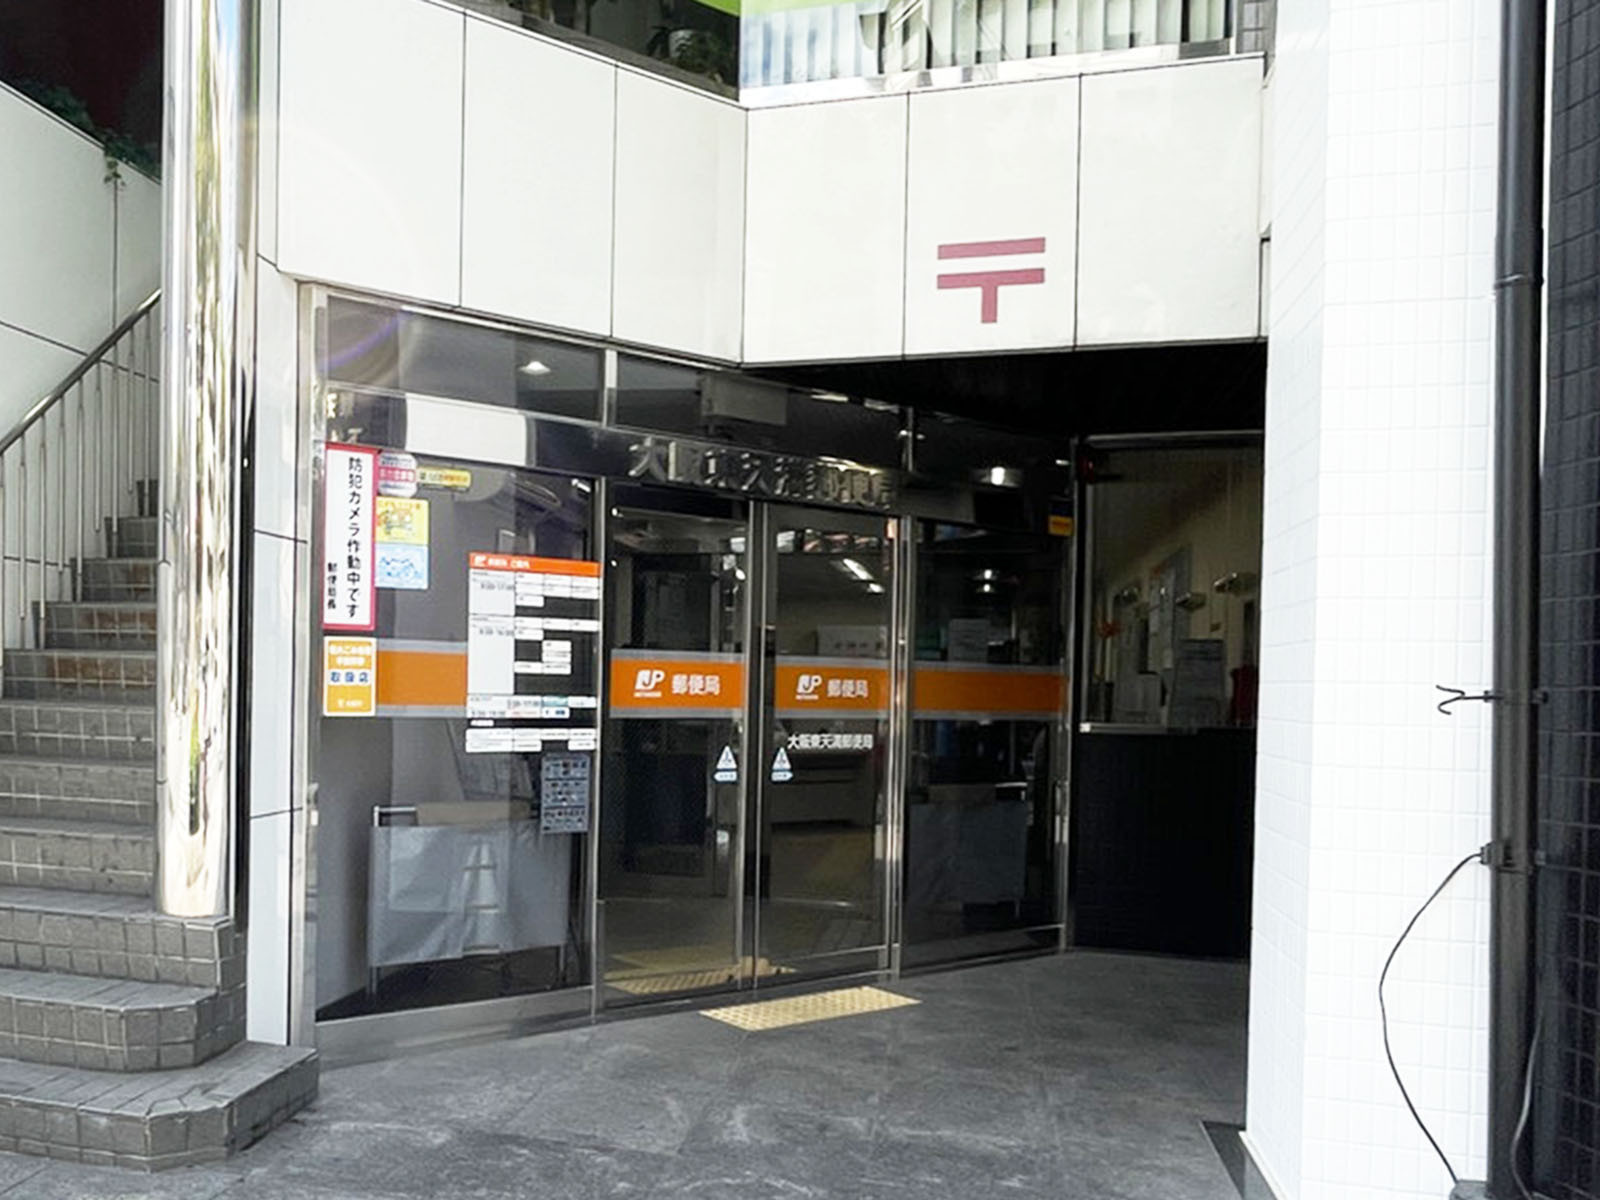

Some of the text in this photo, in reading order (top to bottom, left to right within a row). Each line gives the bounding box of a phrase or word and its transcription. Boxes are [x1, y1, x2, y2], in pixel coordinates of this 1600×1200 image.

[346, 457, 363, 618] 防犯カメラ作動中です
[672, 673, 720, 695] 郵便局
[827, 678, 869, 699] 郵便局
